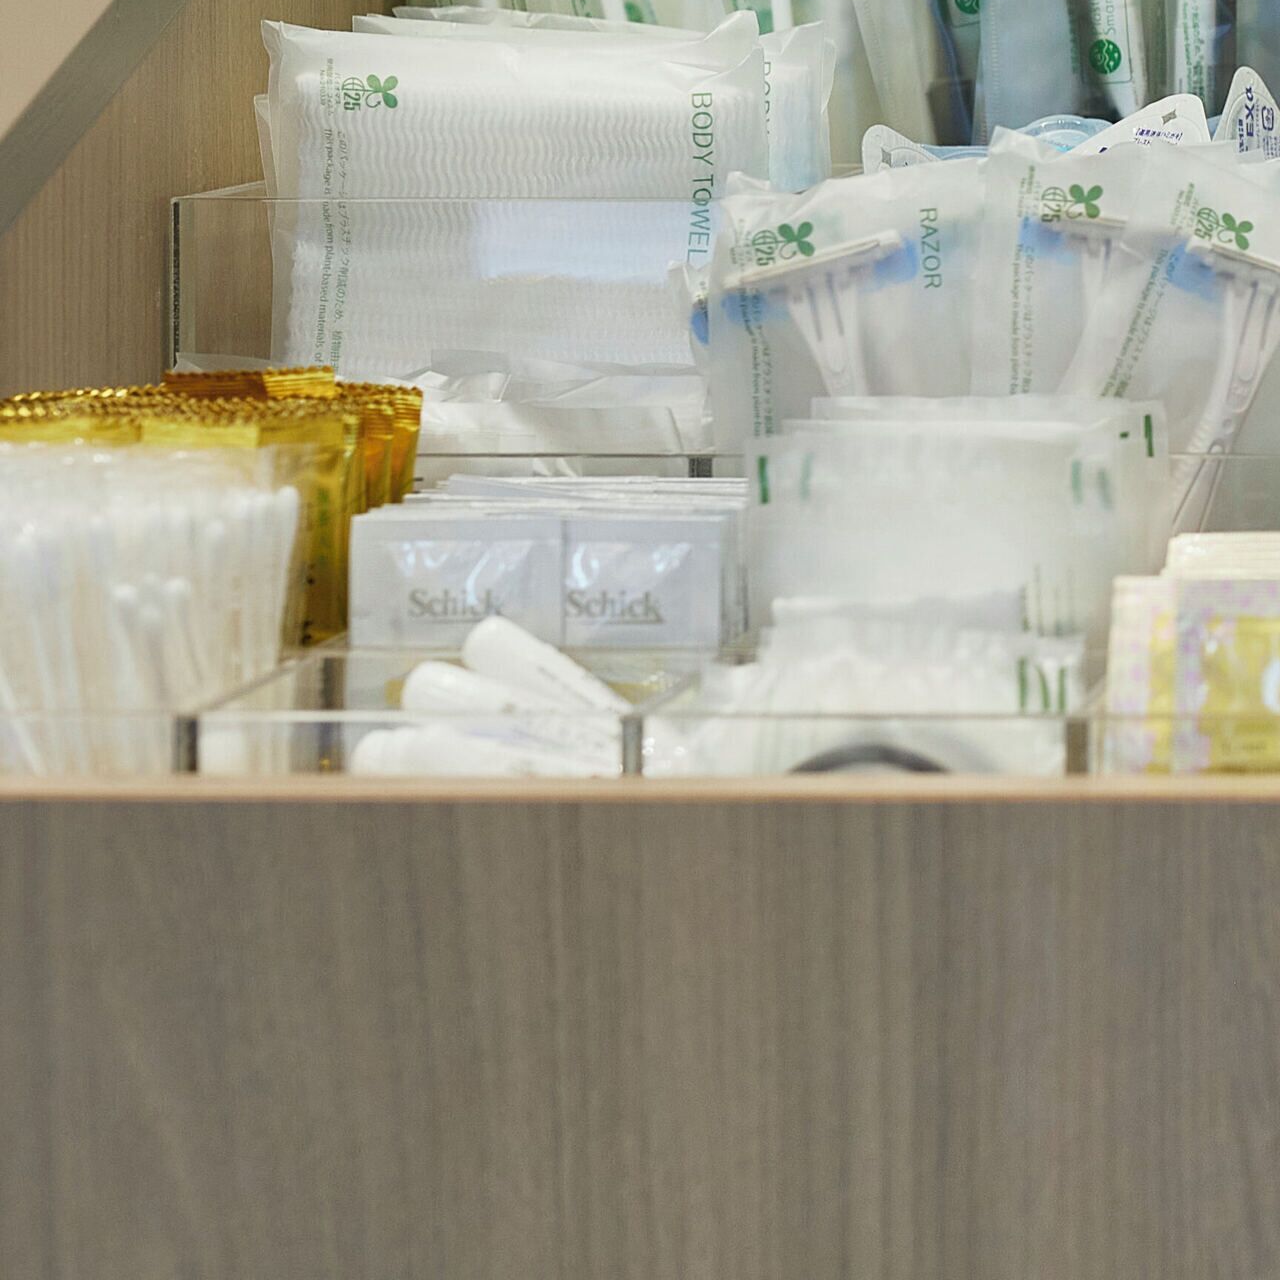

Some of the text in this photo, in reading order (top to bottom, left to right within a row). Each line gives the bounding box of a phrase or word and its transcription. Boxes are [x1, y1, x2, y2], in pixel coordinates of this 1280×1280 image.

[343, 92, 362, 111] 25
[686, 92, 714, 264] BODY TOWEL
[1041, 202, 1061, 223] 25
[324, 223, 334, 245] from
[1194, 221, 1213, 239] 25
[754, 246, 777, 266] 25
[920, 207, 943, 289] RAZOR
[319, 245, 334, 303] plant-based
[314, 304, 327, 349] materials
[313, 353, 323, 363] of
[566, 589, 664, 622] Schick
